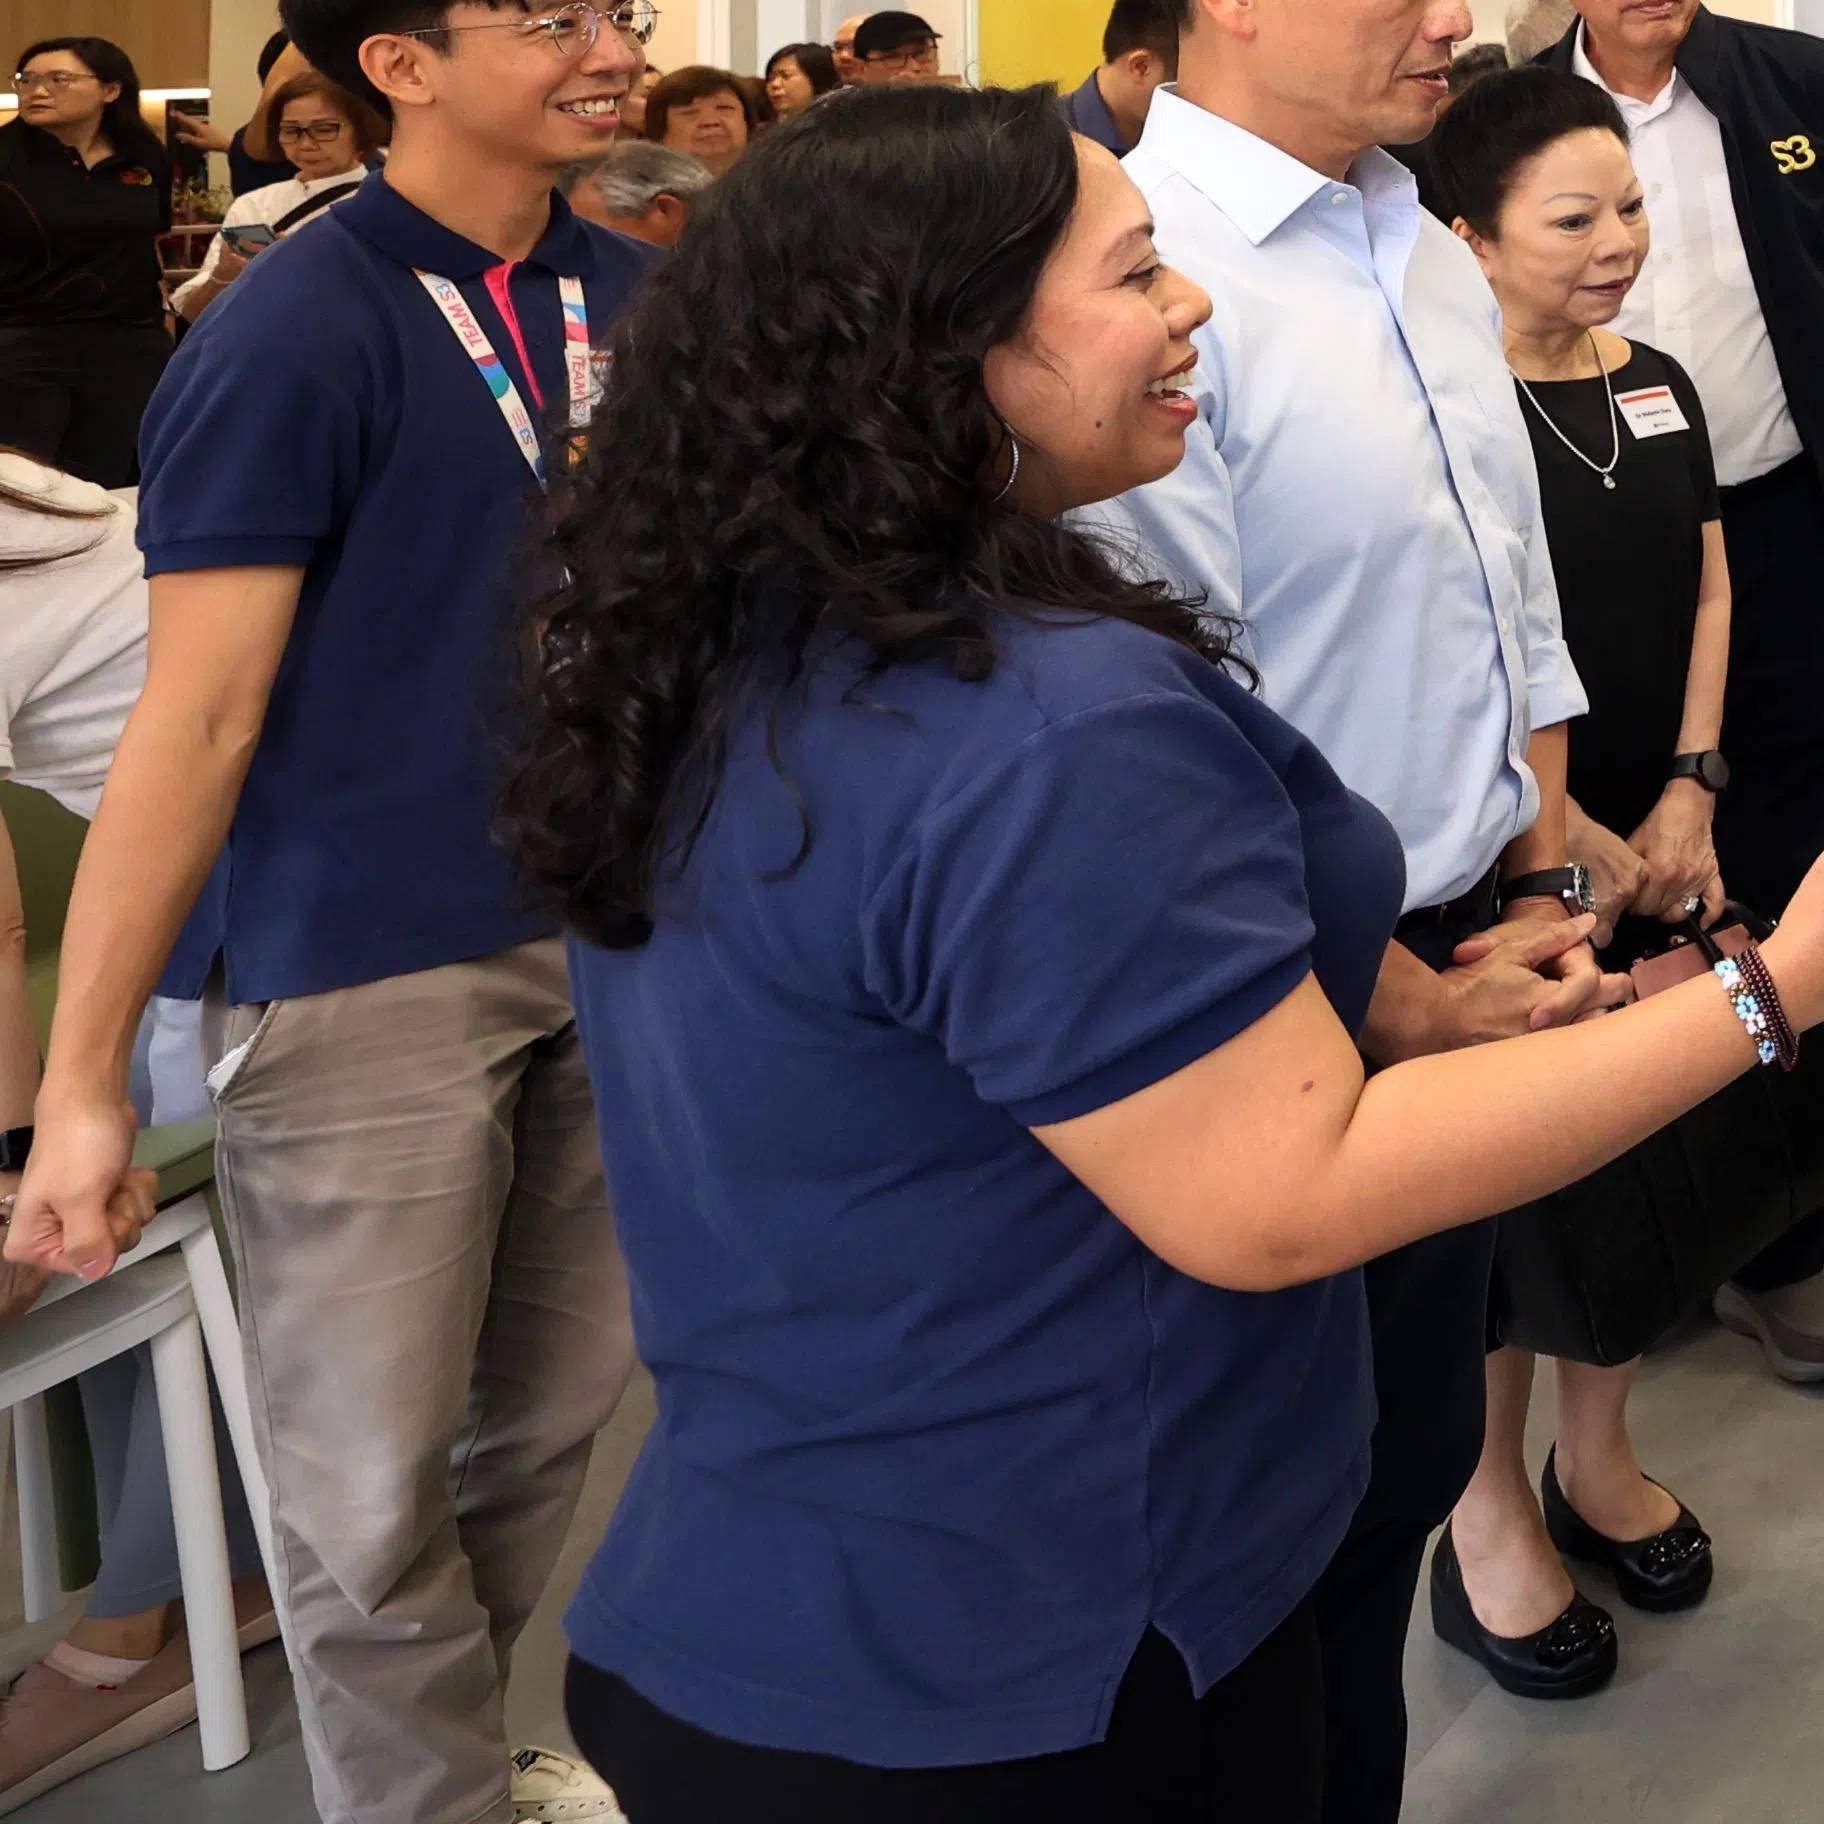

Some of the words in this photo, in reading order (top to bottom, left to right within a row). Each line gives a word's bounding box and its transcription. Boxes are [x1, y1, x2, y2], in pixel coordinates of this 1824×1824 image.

[1771, 135, 1816, 174] S3
[448, 304, 483, 347] TEAM
[572, 354, 587, 397] TEAM
